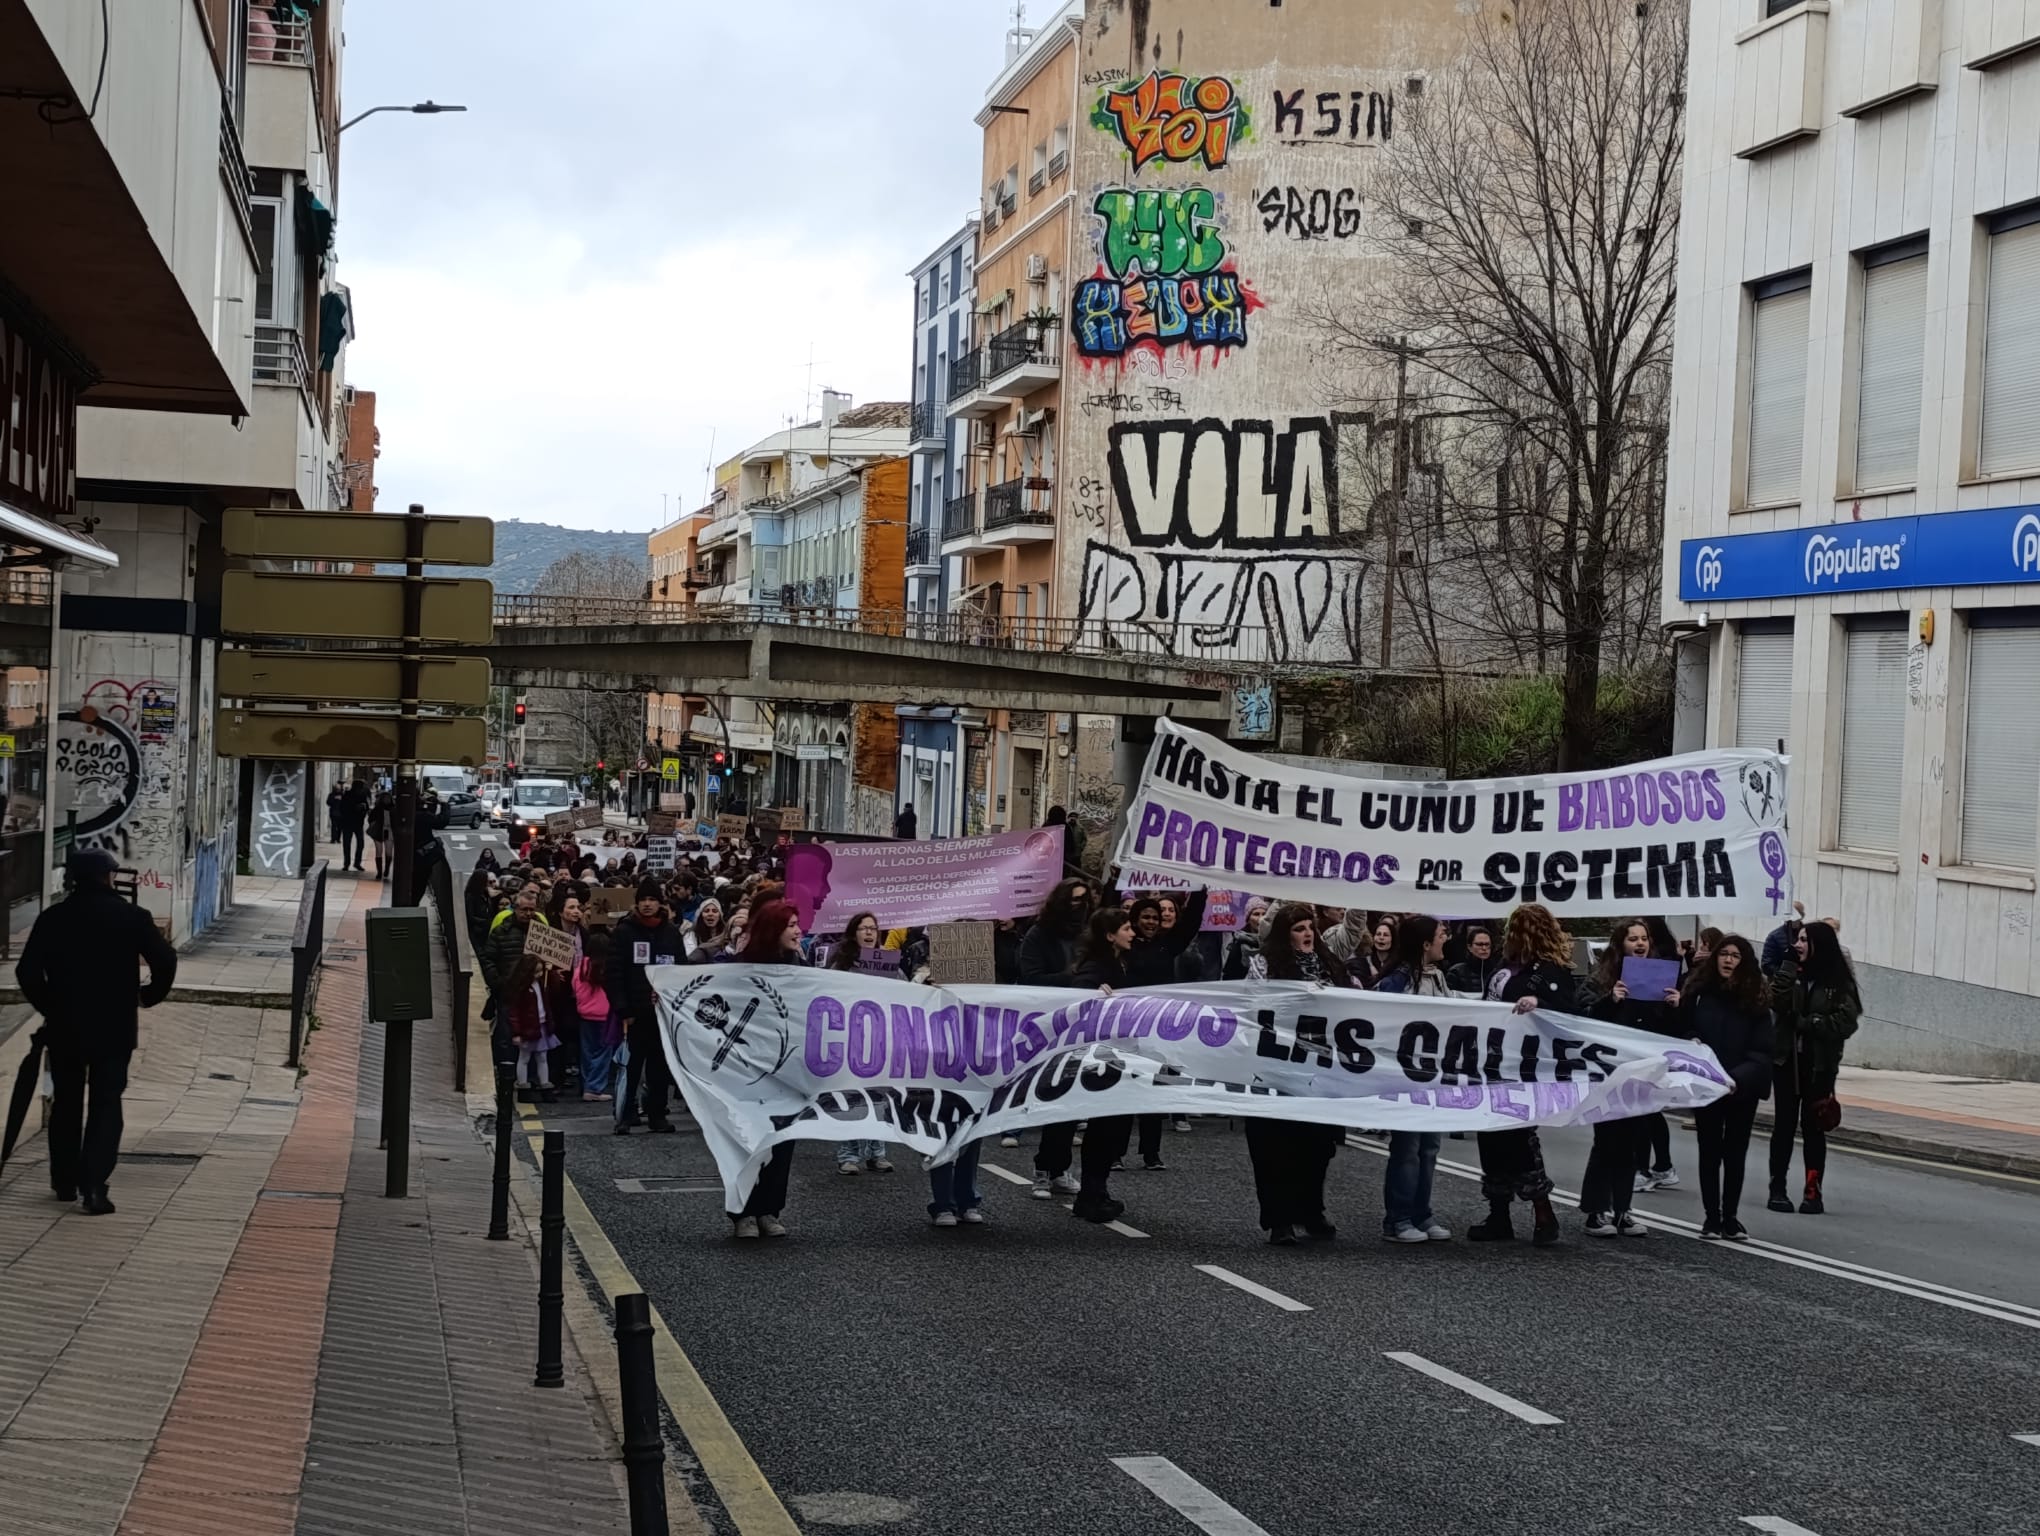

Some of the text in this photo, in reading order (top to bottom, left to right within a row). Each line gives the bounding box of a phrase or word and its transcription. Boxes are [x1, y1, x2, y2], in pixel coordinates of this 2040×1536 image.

[1807, 537, 1900, 584] populares
[1154, 733, 1280, 814] HASTA
[1296, 784, 1343, 826] EL
[1492, 789, 1545, 834] DE
[1558, 768, 1726, 833] BABOSOS
[835, 837, 994, 857] LAS MATRONAS SIEMPRE
[873, 846, 1021, 868] AL LADO DE LAS MUJERES
[1134, 801, 1400, 886] PROTEGIDOS
[1418, 858, 1463, 883] POR
[1478, 838, 1738, 903] SISTEMA
[862, 876, 907, 884] VELAMOS
[909, 874, 929, 882] POR
[930, 872, 942, 880] LA
[943, 868, 982, 879] DEFENSA
[983, 867, 997, 875] DE
[866, 886, 885, 895] LOS
[886, 881, 950, 894] DERECHOS
[951, 877, 999, 888] SEXUALES
[843, 894, 922, 906] REPRODUCTIVOS
[922, 893, 937, 901] DE
[937, 891, 955, 900] LAS
[955, 886, 1000, 897] MUJERES
[542, 936, 557, 949] NO
[872, 950, 884, 960] EL
[930, 959, 993, 981] MUJER
[1256, 1009, 1376, 1074] LAS
